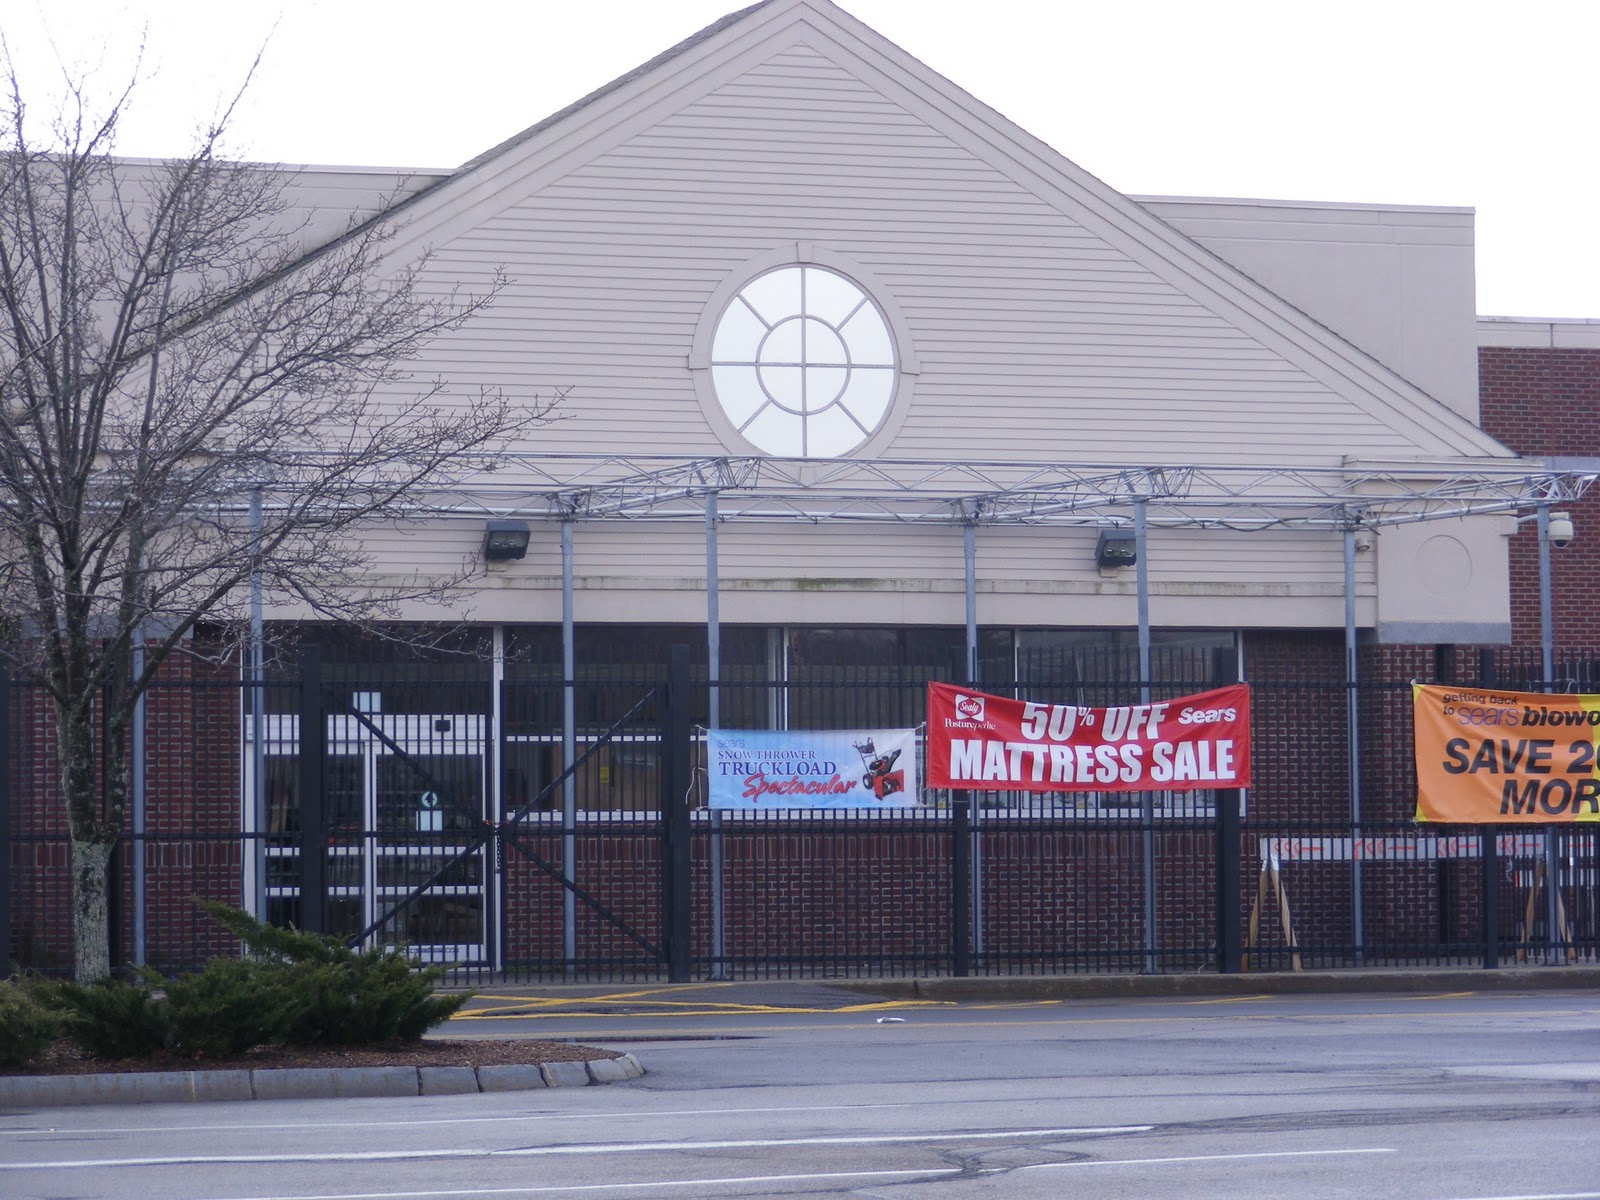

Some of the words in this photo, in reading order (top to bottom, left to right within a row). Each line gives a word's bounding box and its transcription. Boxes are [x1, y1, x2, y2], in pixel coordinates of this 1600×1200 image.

[960, 701, 979, 714] Sealy
[1442, 693, 1486, 704] getting
[1489, 695, 1519, 705] back
[1020, 702, 1095, 741] 50%
[1101, 703, 1169, 742] OFF
[1178, 707, 1236, 725] Sears
[1443, 705, 1455, 716] to
[1457, 706, 1520, 726] sears
[717, 738, 745, 748] sears
[718, 751, 752, 760] SNOW
[756, 750, 816, 759] THROWER
[950, 739, 1144, 783] MATTRESS
[1150, 740, 1236, 781] SALE
[1442, 738, 1555, 774] SAVE
[1566, 739, 1600, 774] 2
[718, 761, 837, 776] TRUCKLOAD
[742, 773, 857, 803] Spectacular
[1500, 779, 1600, 815] MOR
